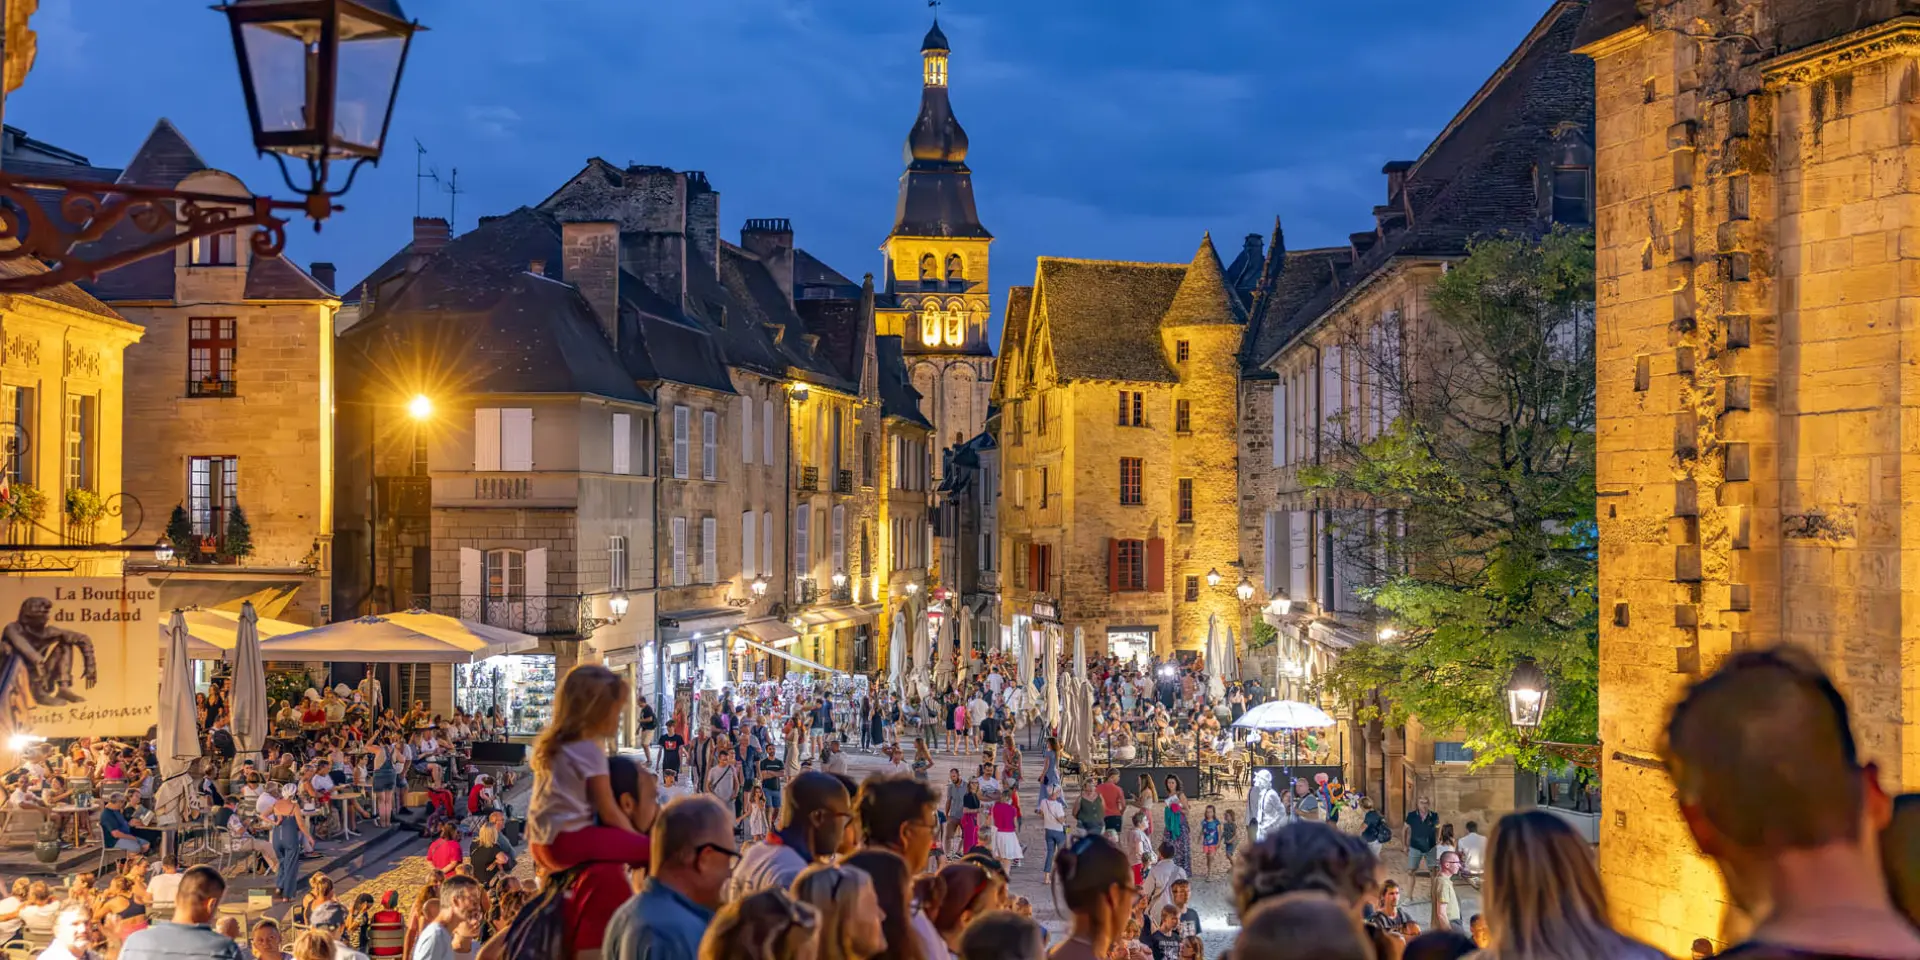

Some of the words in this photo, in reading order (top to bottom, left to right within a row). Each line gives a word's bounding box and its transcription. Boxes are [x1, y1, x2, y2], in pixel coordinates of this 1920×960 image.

[55, 586, 76, 600] La
[82, 586, 155, 604] Boutique
[54, 607, 74, 622] du
[81, 607, 141, 622] Badaud
[67, 705, 152, 729] Régionaux
